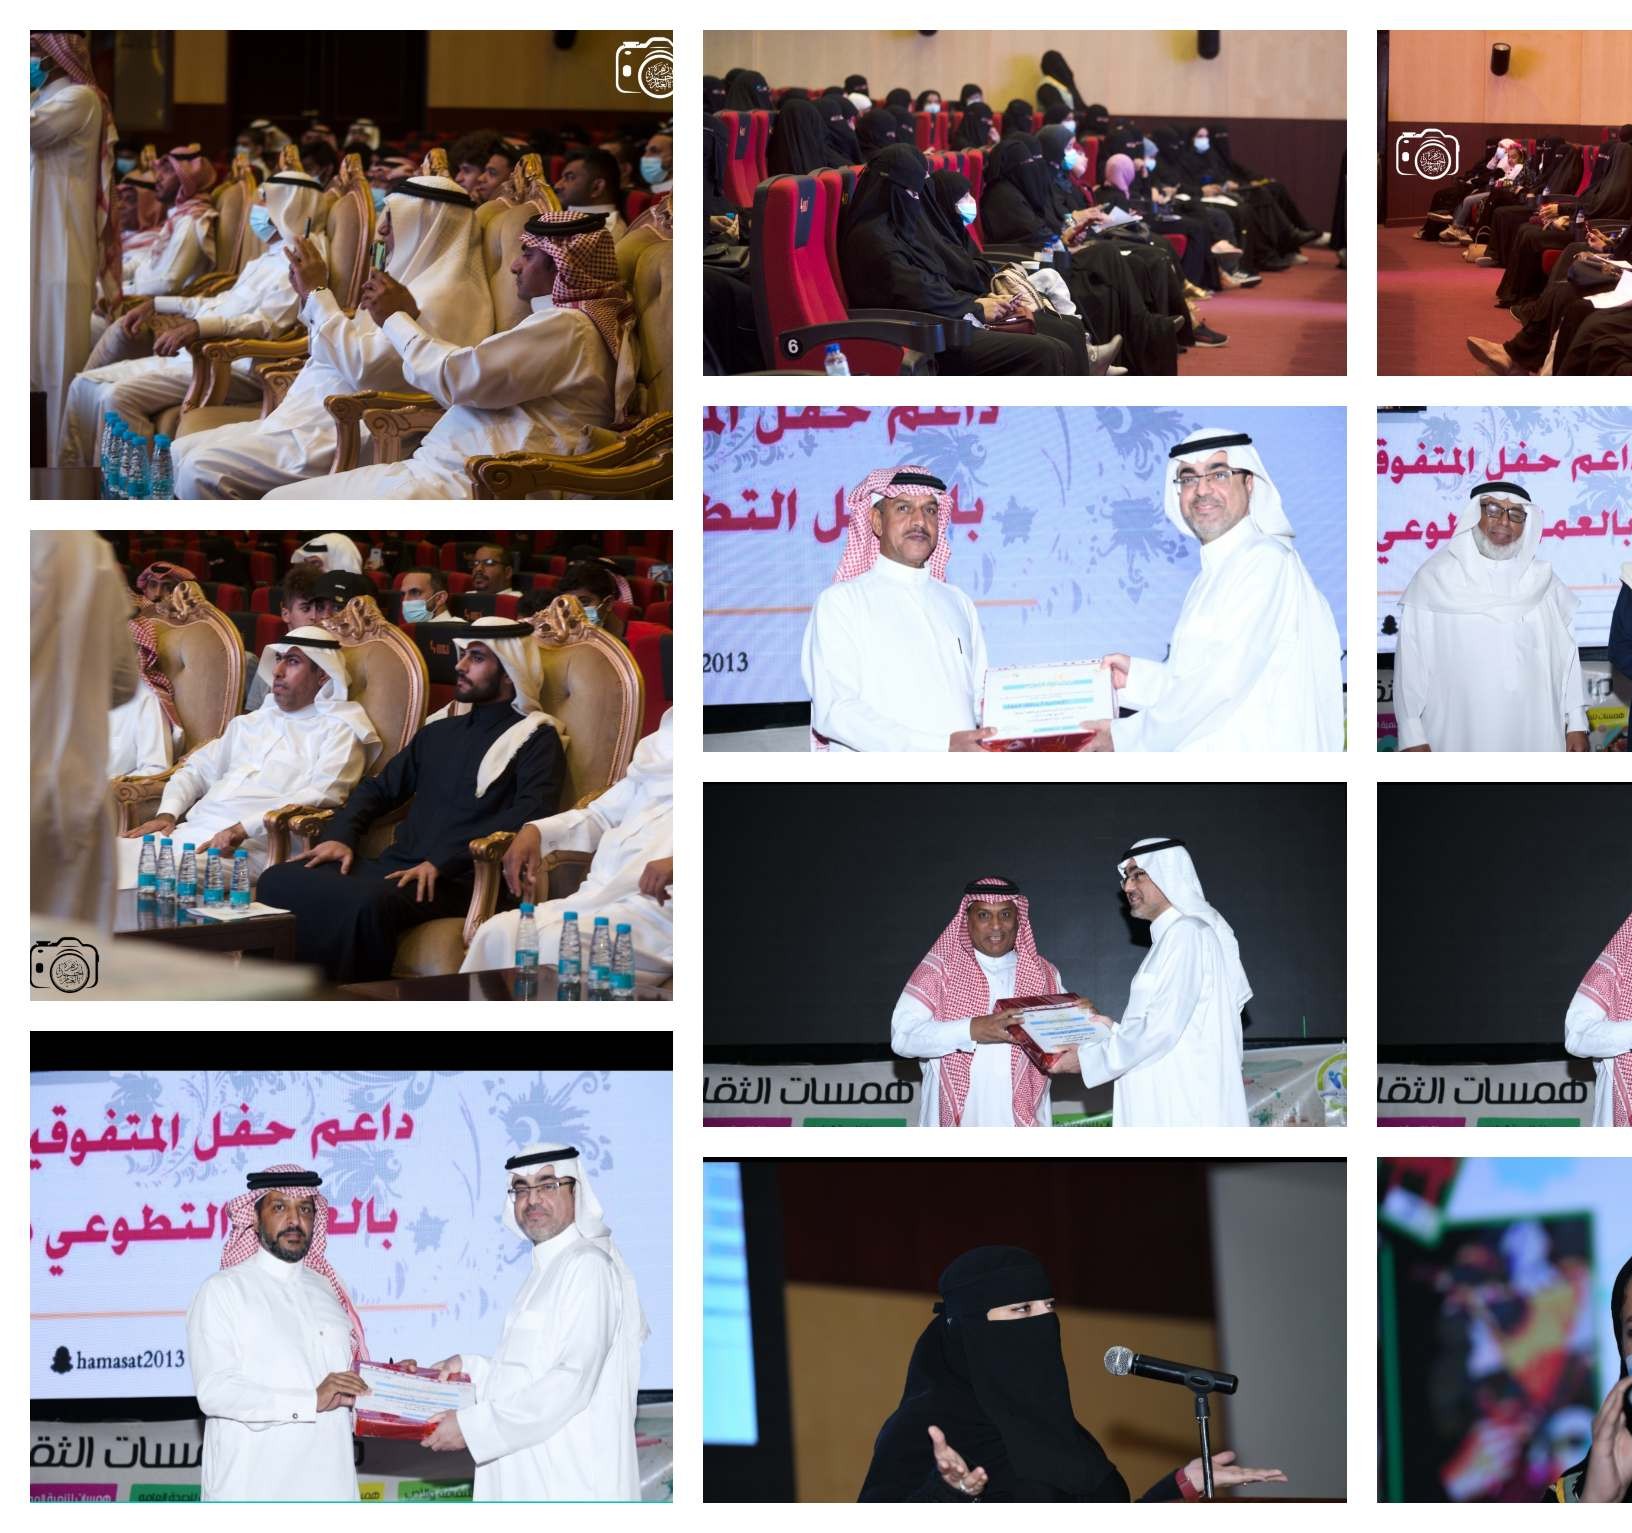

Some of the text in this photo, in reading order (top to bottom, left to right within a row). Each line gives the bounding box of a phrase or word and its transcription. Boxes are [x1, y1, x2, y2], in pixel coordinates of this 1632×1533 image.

[788, 339, 799, 354] 6
[1485, 441, 1561, 481] حفل
[780, 1077, 914, 1105] همسات
[1454, 1077, 1588, 1105] همسات
[194, 1103, 296, 1161] حفل
[311, 1102, 414, 1159] داعم
[45, 1202, 229, 1277] التطوعي
[76, 1349, 185, 1370] hamasat2013
